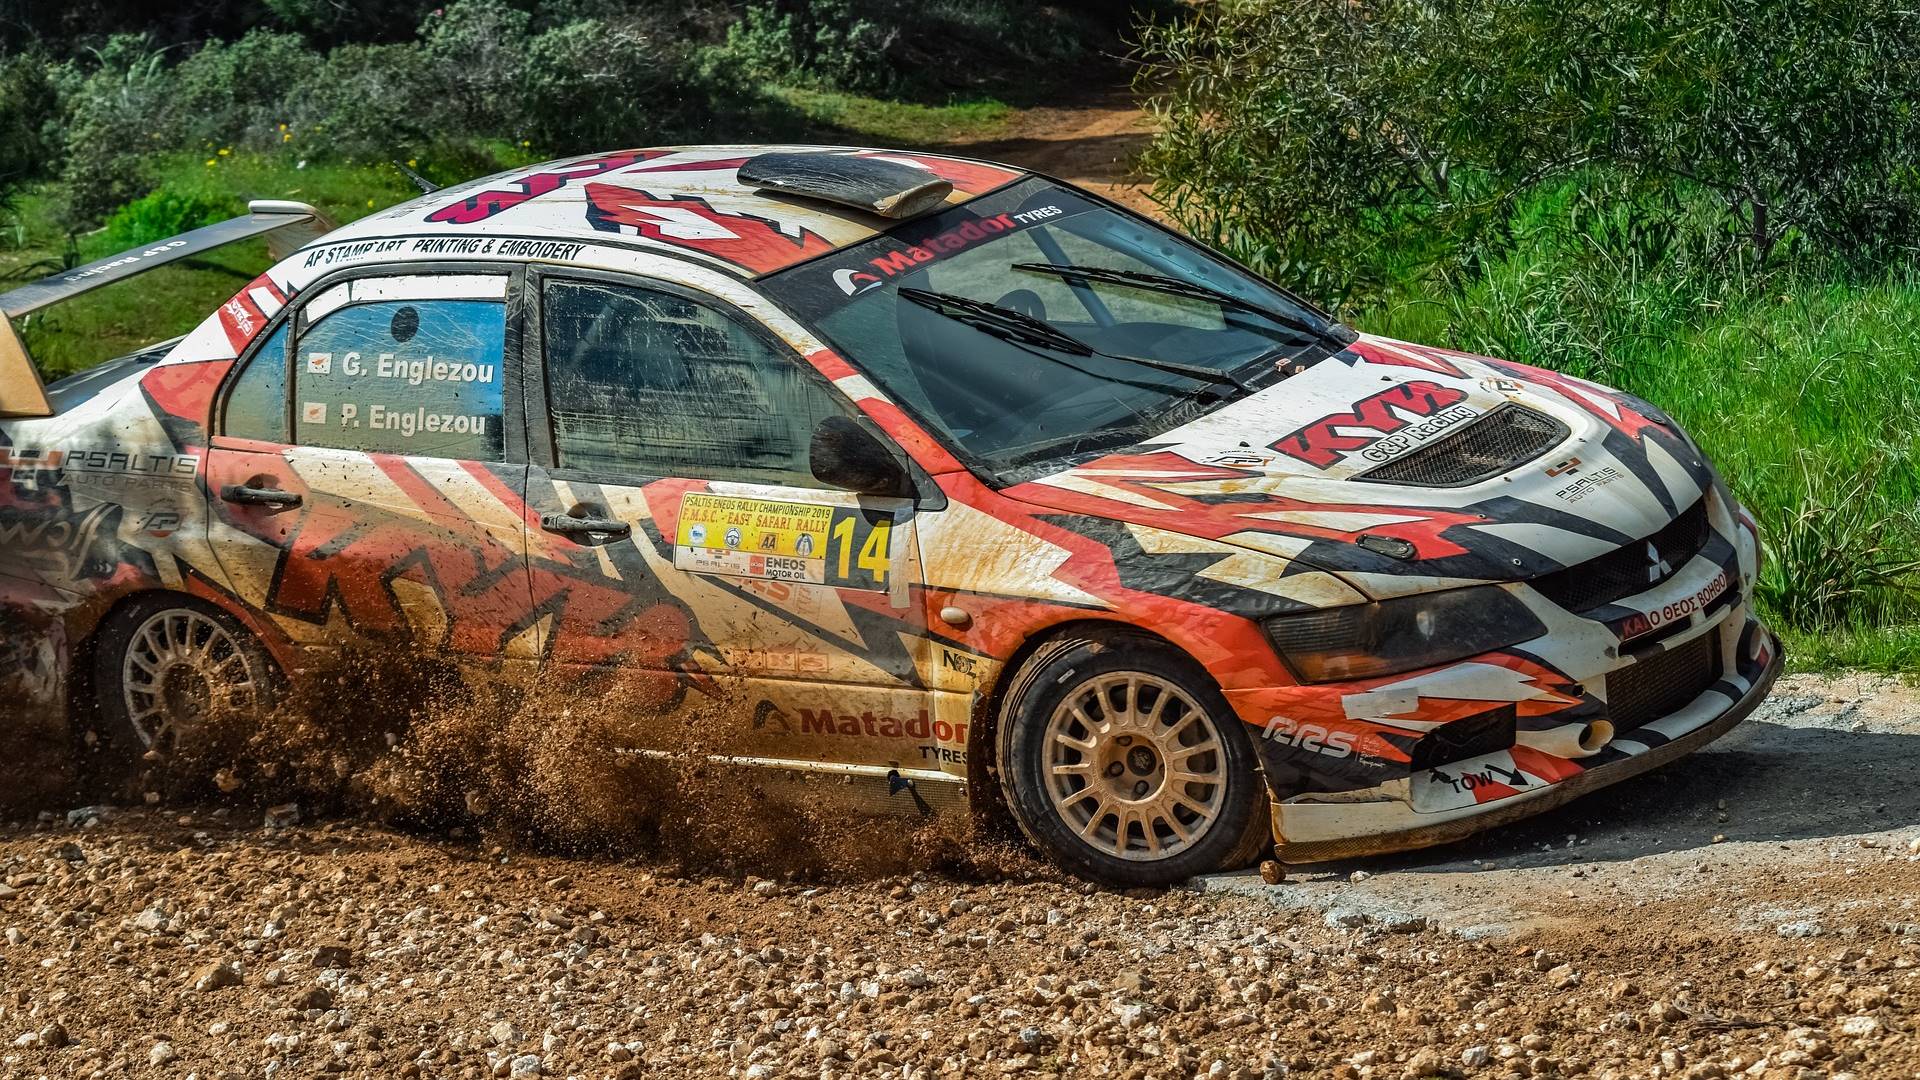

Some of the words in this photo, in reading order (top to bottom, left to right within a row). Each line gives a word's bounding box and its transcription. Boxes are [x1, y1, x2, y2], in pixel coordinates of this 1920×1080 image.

[303, 249, 326, 269] AP
[412, 238, 480, 254] PRINTING
[481, 239, 495, 254] &
[497, 239, 588, 261] EMBOIDERY
[869, 211, 1017, 277] Matador
[1014, 204, 1064, 224] TYRES
[342, 351, 369, 376] G.
[376, 353, 494, 386] Englezou
[341, 403, 360, 428] P.
[369, 404, 486, 437] Englezou
[1265, 379, 1469, 471] KYB
[1361, 434, 1411, 463] G&P
[1401, 405, 1479, 441] Racing
[65, 450, 198, 475] PSALTIS
[61, 472, 116, 487] AUTO
[124, 477, 193, 494] PARTS
[1555, 466, 1616, 499] PSALTIS
[1569, 486, 1596, 504] AUTO
[685, 496, 712, 507] PSALTIS
[713, 498, 736, 510] ENEOS
[736, 501, 759, 512] RALLY
[758, 504, 811, 517] CHAMPIONSHIP
[812, 508, 831, 519] 2019
[727, 512, 752, 527] EAST
[755, 515, 790, 530] SAFARI
[795, 520, 828, 534] RALLY
[761, 536, 776, 550] AA
[833, 515, 891, 584] 14
[696, 559, 740, 570] PSALTIS
[765, 556, 806, 571] ENEOS
[765, 566, 792, 578] MOTOR
[793, 570, 806, 580] OIL
[800, 708, 969, 745] Matador
[1261, 715, 1358, 758] RRS
[1451, 770, 1494, 794] TOW
